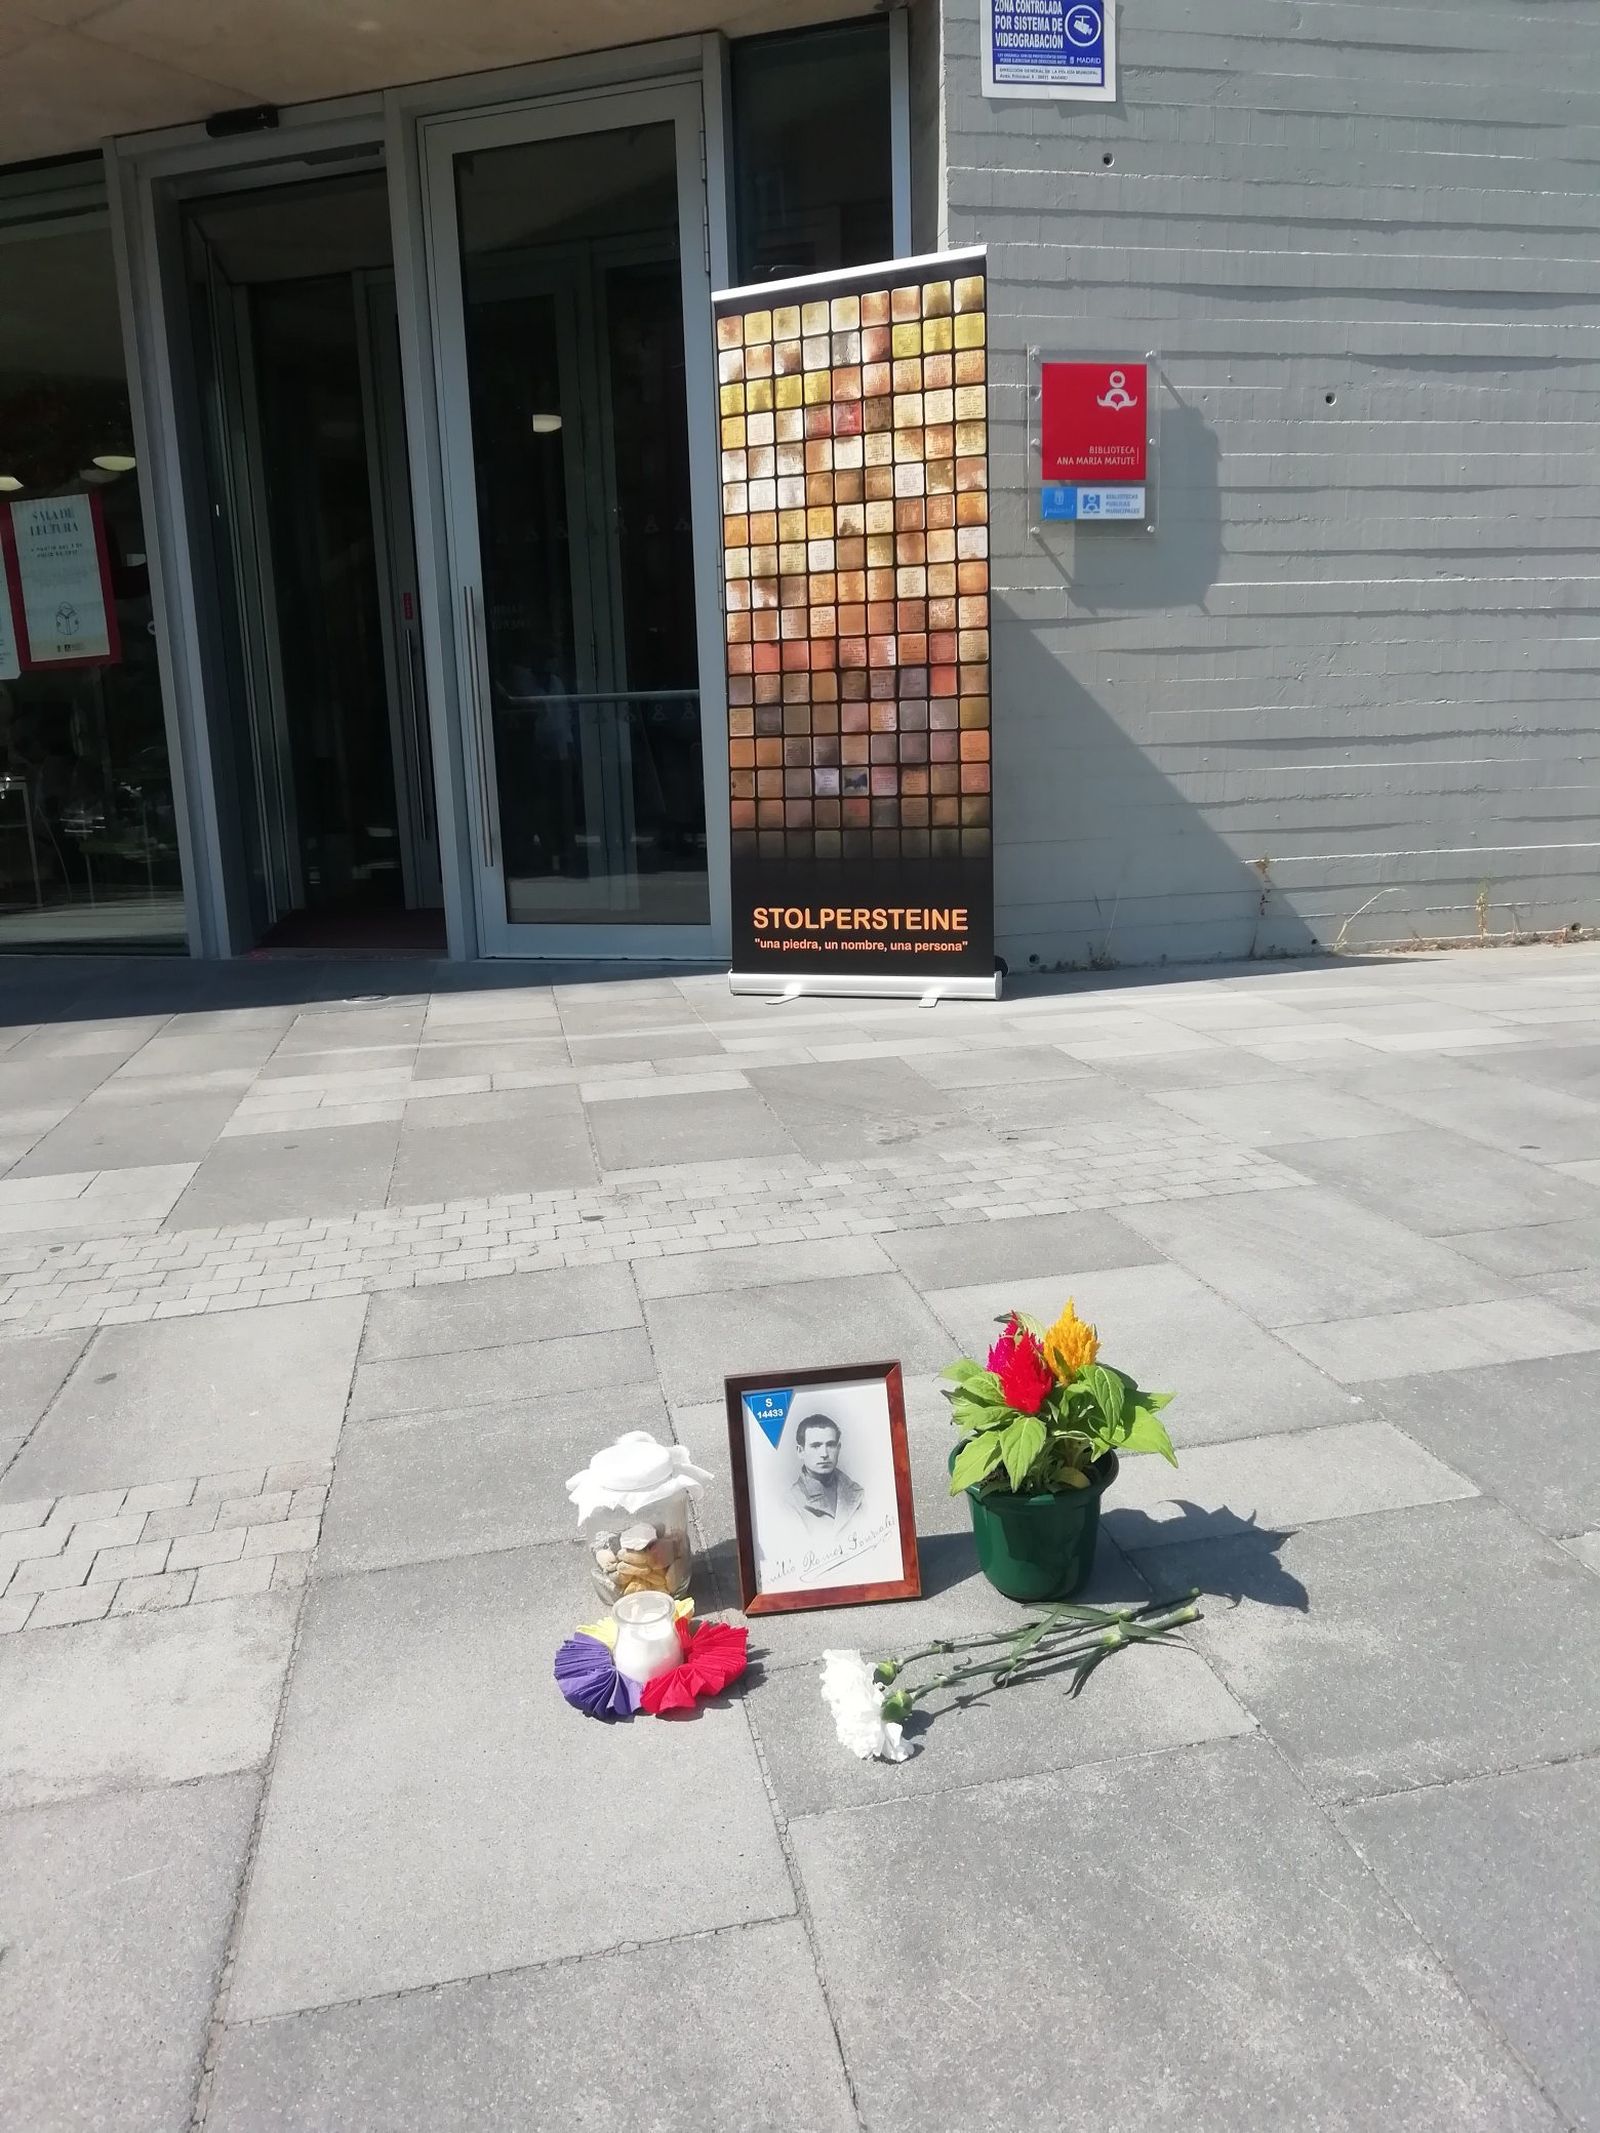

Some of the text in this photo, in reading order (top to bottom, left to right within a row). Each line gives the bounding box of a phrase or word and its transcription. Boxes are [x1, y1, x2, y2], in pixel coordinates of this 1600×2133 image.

[995, 0, 1062, 15] ZONA CONTROLADA
[995, 15, 1063, 32] POR SISTEMA DE
[995, 31, 1063, 48] VIDEOGRABACIÓN
[1089, 445, 1136, 454] BIBLIOTECA
[1056, 456, 1075, 465] ANA
[1104, 456, 1136, 465] MATUTE
[30, 522, 79, 536] LECTURA
[753, 907, 969, 931] STOLPERSTEINE
[782, 938, 822, 951] piedra,
[825, 941, 838, 950] un
[841, 940, 887, 952] nombre,
[890, 942, 911, 951] una
[765, 1398, 773, 1407] S
[757, 1408, 783, 1418] 14433
